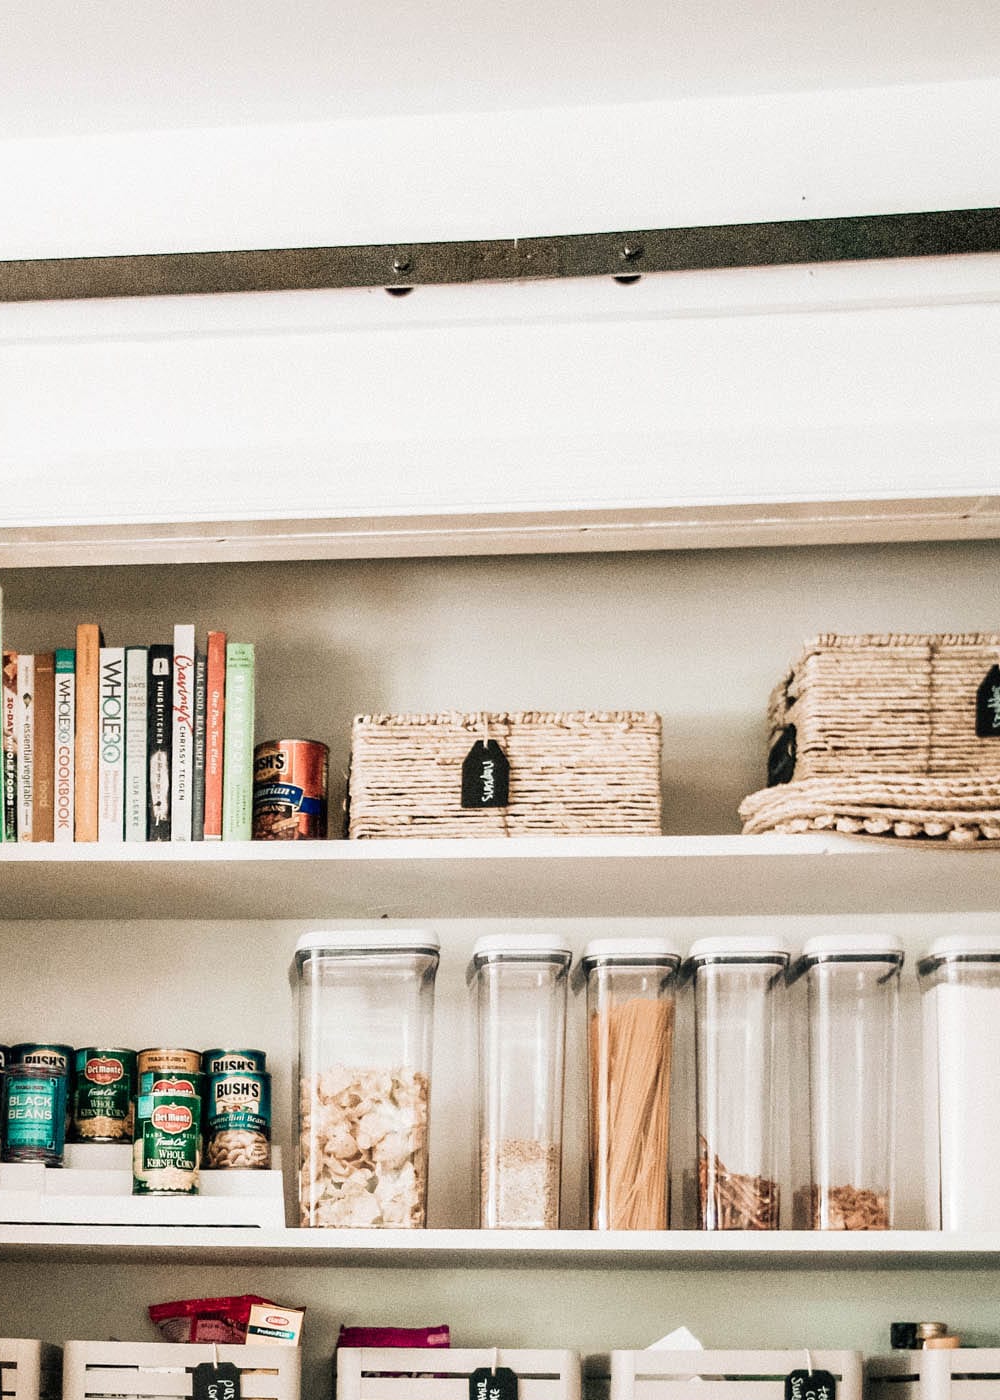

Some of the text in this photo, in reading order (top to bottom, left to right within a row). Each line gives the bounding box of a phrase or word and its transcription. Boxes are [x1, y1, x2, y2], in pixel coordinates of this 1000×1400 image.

[196, 662, 205, 684] REAL
[102, 659, 122, 763] WHOLE30
[173, 655, 193, 733] Cravings
[211, 691, 220, 707] One
[6, 697, 15, 734] 30-DAY
[58, 679, 70, 744] WHOLE30
[196, 715, 204, 737] REAL
[6, 735, 14, 771] WHOLE
[23, 723, 32, 763] essential
[179, 726, 187, 766] CHRISSY
[195, 739, 204, 770] SIMPLE
[210, 748, 218, 775] Plates
[6, 772, 15, 806] FOODS
[21, 764, 32, 807] vegetable
[58, 745, 70, 829] COOKBOOK
[8, 1095, 53, 1107] BLACK
[216, 1083, 260, 1098] BUSH'S
[8, 1108, 53, 1120] BEANS
[158, 1149, 186, 1160] WHOLE
